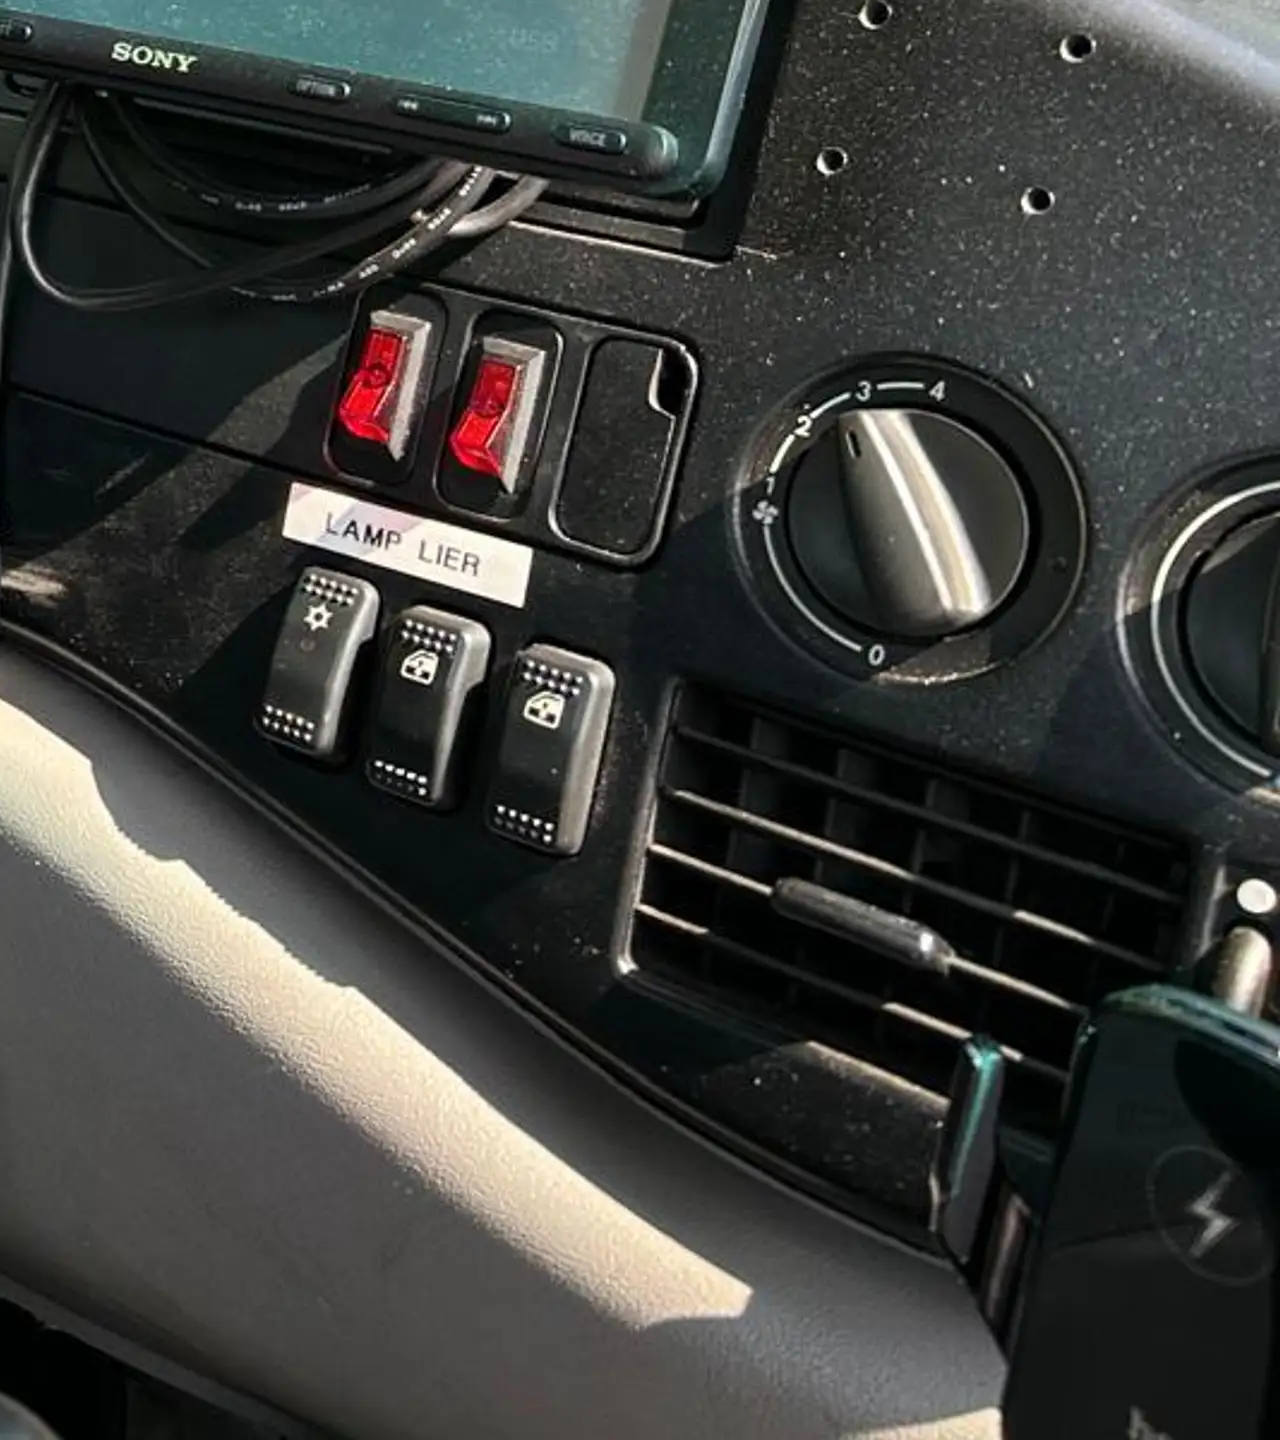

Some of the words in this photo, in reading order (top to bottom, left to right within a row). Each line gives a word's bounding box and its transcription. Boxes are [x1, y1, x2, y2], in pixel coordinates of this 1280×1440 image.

[110, 40, 200, 74] SONY
[854, 379, 873, 403] 3
[927, 380, 948, 402] 4
[792, 414, 813, 439] 2
[764, 474, 776, 495] 1
[324, 510, 404, 551] LAMP
[417, 536, 483, 578] LIER
[867, 643, 886, 667] 0
